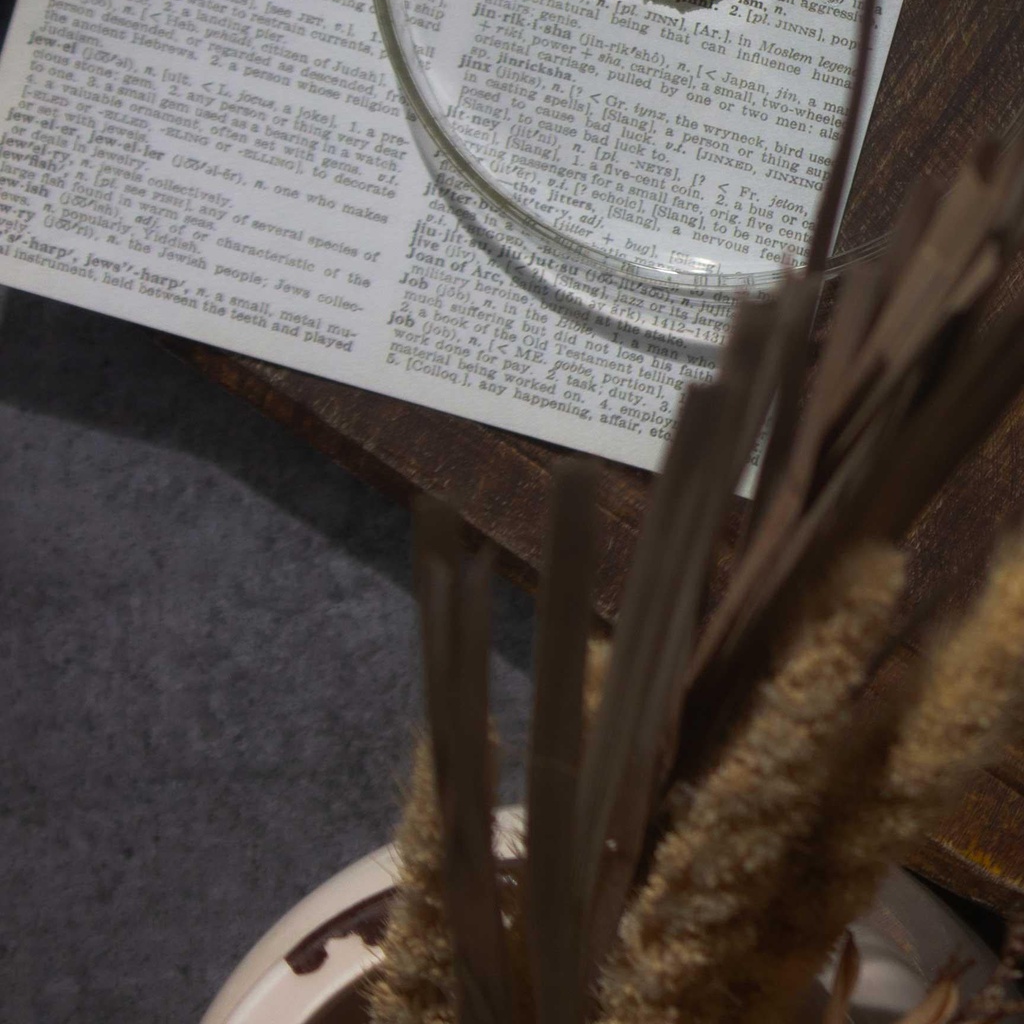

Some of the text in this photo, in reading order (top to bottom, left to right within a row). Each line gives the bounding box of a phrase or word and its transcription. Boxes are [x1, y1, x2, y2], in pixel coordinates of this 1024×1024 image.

[497, 51, 576, 82] jinricksha.
[610, 13, 649, 36] being
[659, 28, 691, 45] that
[700, 41, 727, 55] can
[736, 47, 801, 75] influence
[811, 68, 853, 88] huma
[457, 95, 510, 122] [Slang],
[537, 119, 577, 137] cause
[583, 129, 610, 145] bad
[614, 137, 646, 155] luck
[102, 272, 133, 290] held
[138, 283, 198, 308] between
[202, 302, 226, 316] the
[230, 310, 268, 328] teeth
[271, 323, 299, 337] and
[303, 332, 353, 352] played
[410, 265, 468, 290] military
[539, 297, 593, 322] burned
[616, 320, 641, 335] the
[403, 291, 716, 384] much suffering but did not lose his faith
[478, 381, 506, 398] any
